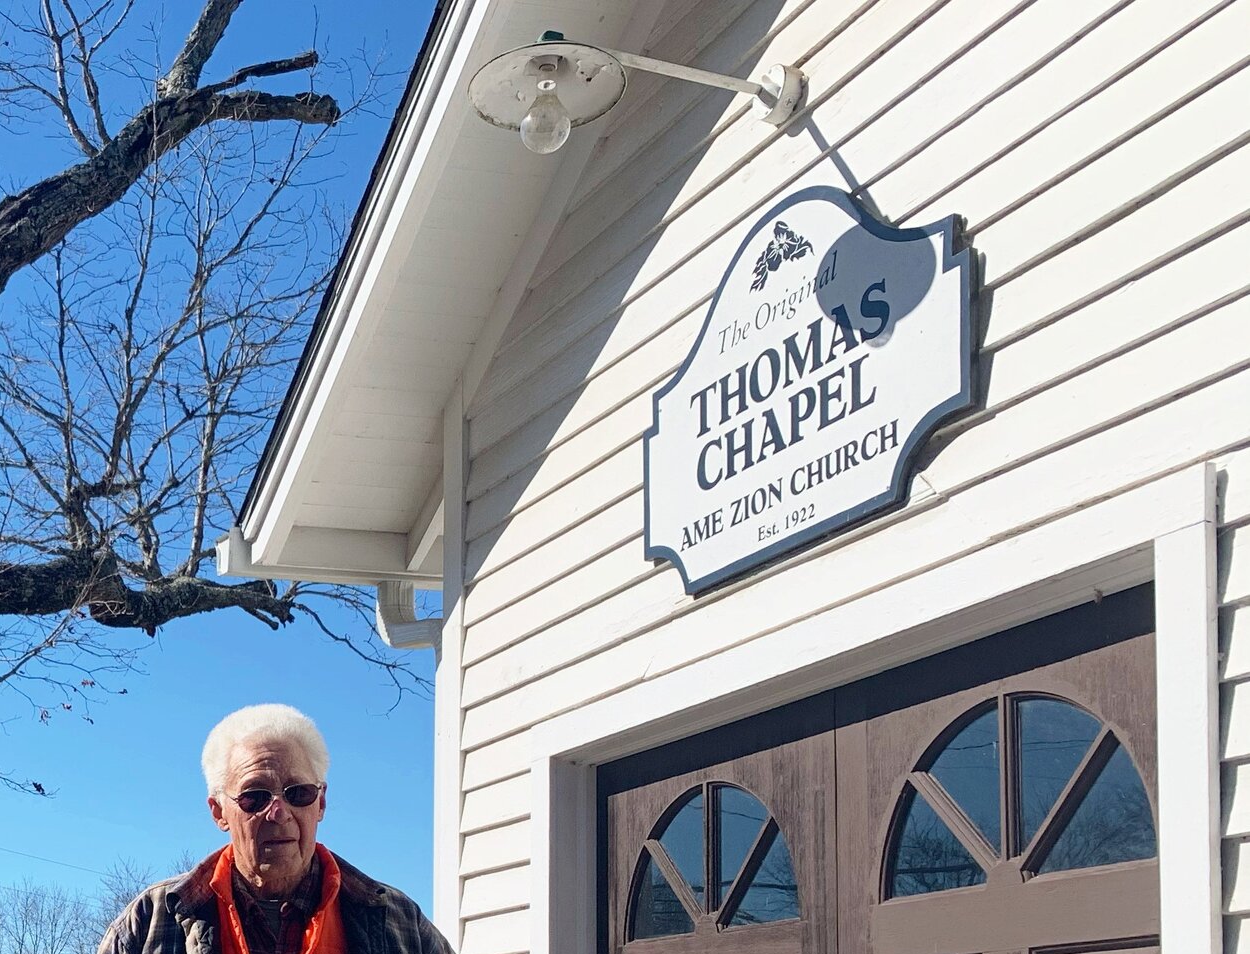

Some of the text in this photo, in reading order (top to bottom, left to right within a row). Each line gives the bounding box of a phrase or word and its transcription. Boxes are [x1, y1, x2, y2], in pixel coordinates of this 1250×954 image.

[690, 278, 890, 439] THOMAS
[717, 250, 838, 356] The Original
[680, 419, 899, 552] AME ZION CHURCH
[696, 353, 878, 491] CHAPEL
[757, 503, 816, 542] Est. 1922
